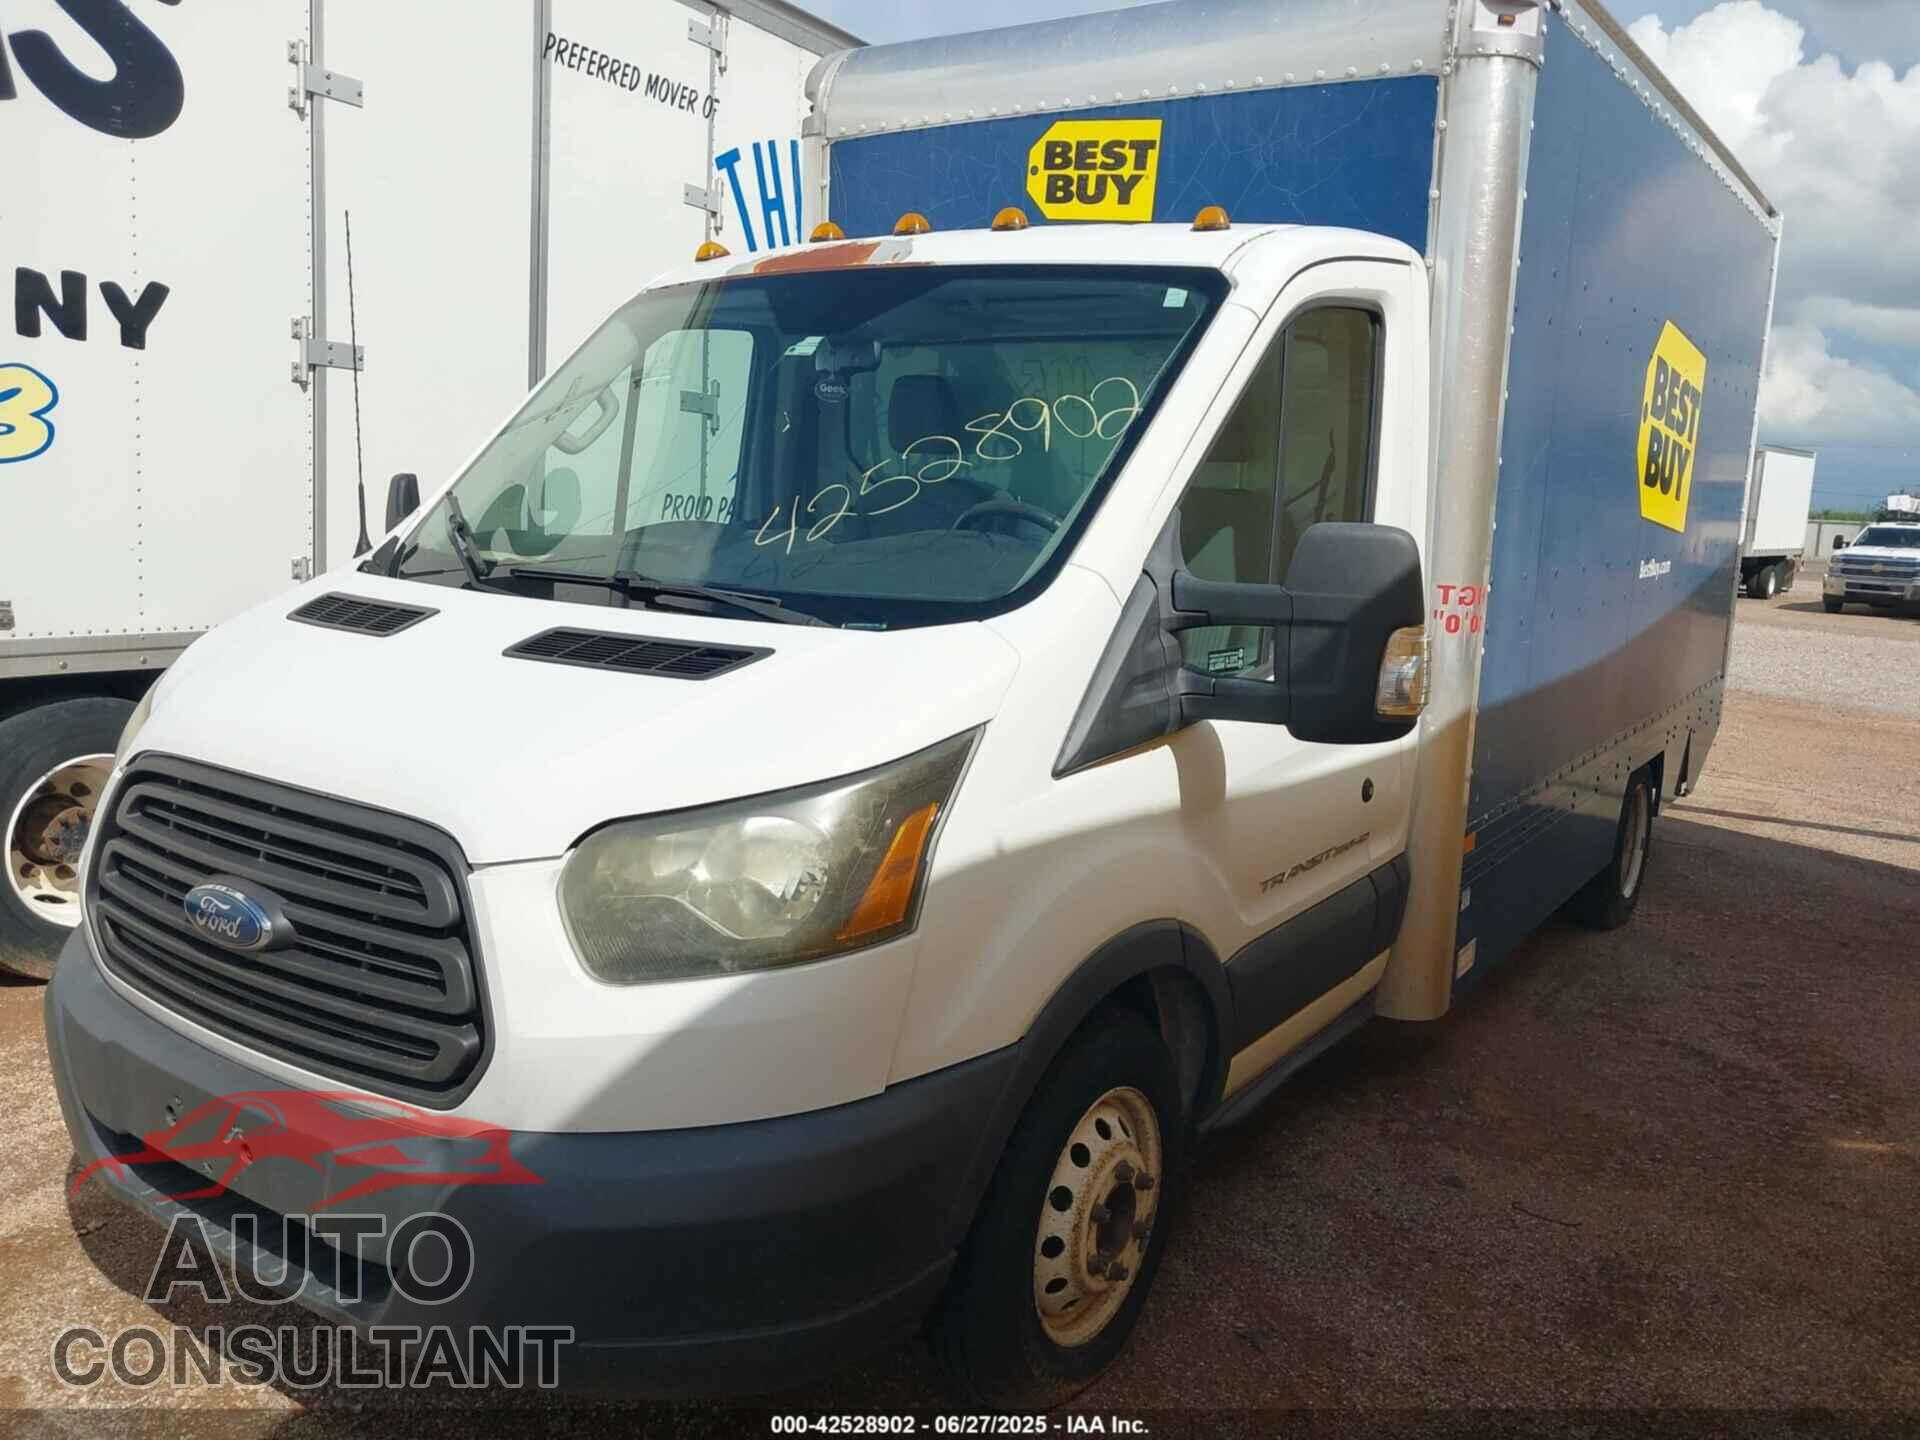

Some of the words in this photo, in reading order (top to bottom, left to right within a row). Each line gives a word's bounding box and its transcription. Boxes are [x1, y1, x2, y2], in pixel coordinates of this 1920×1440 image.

[0, 0, 184, 139] S
[543, 32, 641, 91] PREFERRED
[645, 73, 698, 114] MOVER
[714, 139, 802, 252] TH
[1043, 139, 1157, 171] BEST
[1045, 174, 1144, 205] BUY
[15, 266, 170, 350] NY
[1650, 355, 1700, 443] BEST
[755, 377, 1144, 554] 42528902
[1644, 425, 1690, 501] BUY
[661, 493, 713, 521] PROUD
[195, 895, 242, 939] Ford
